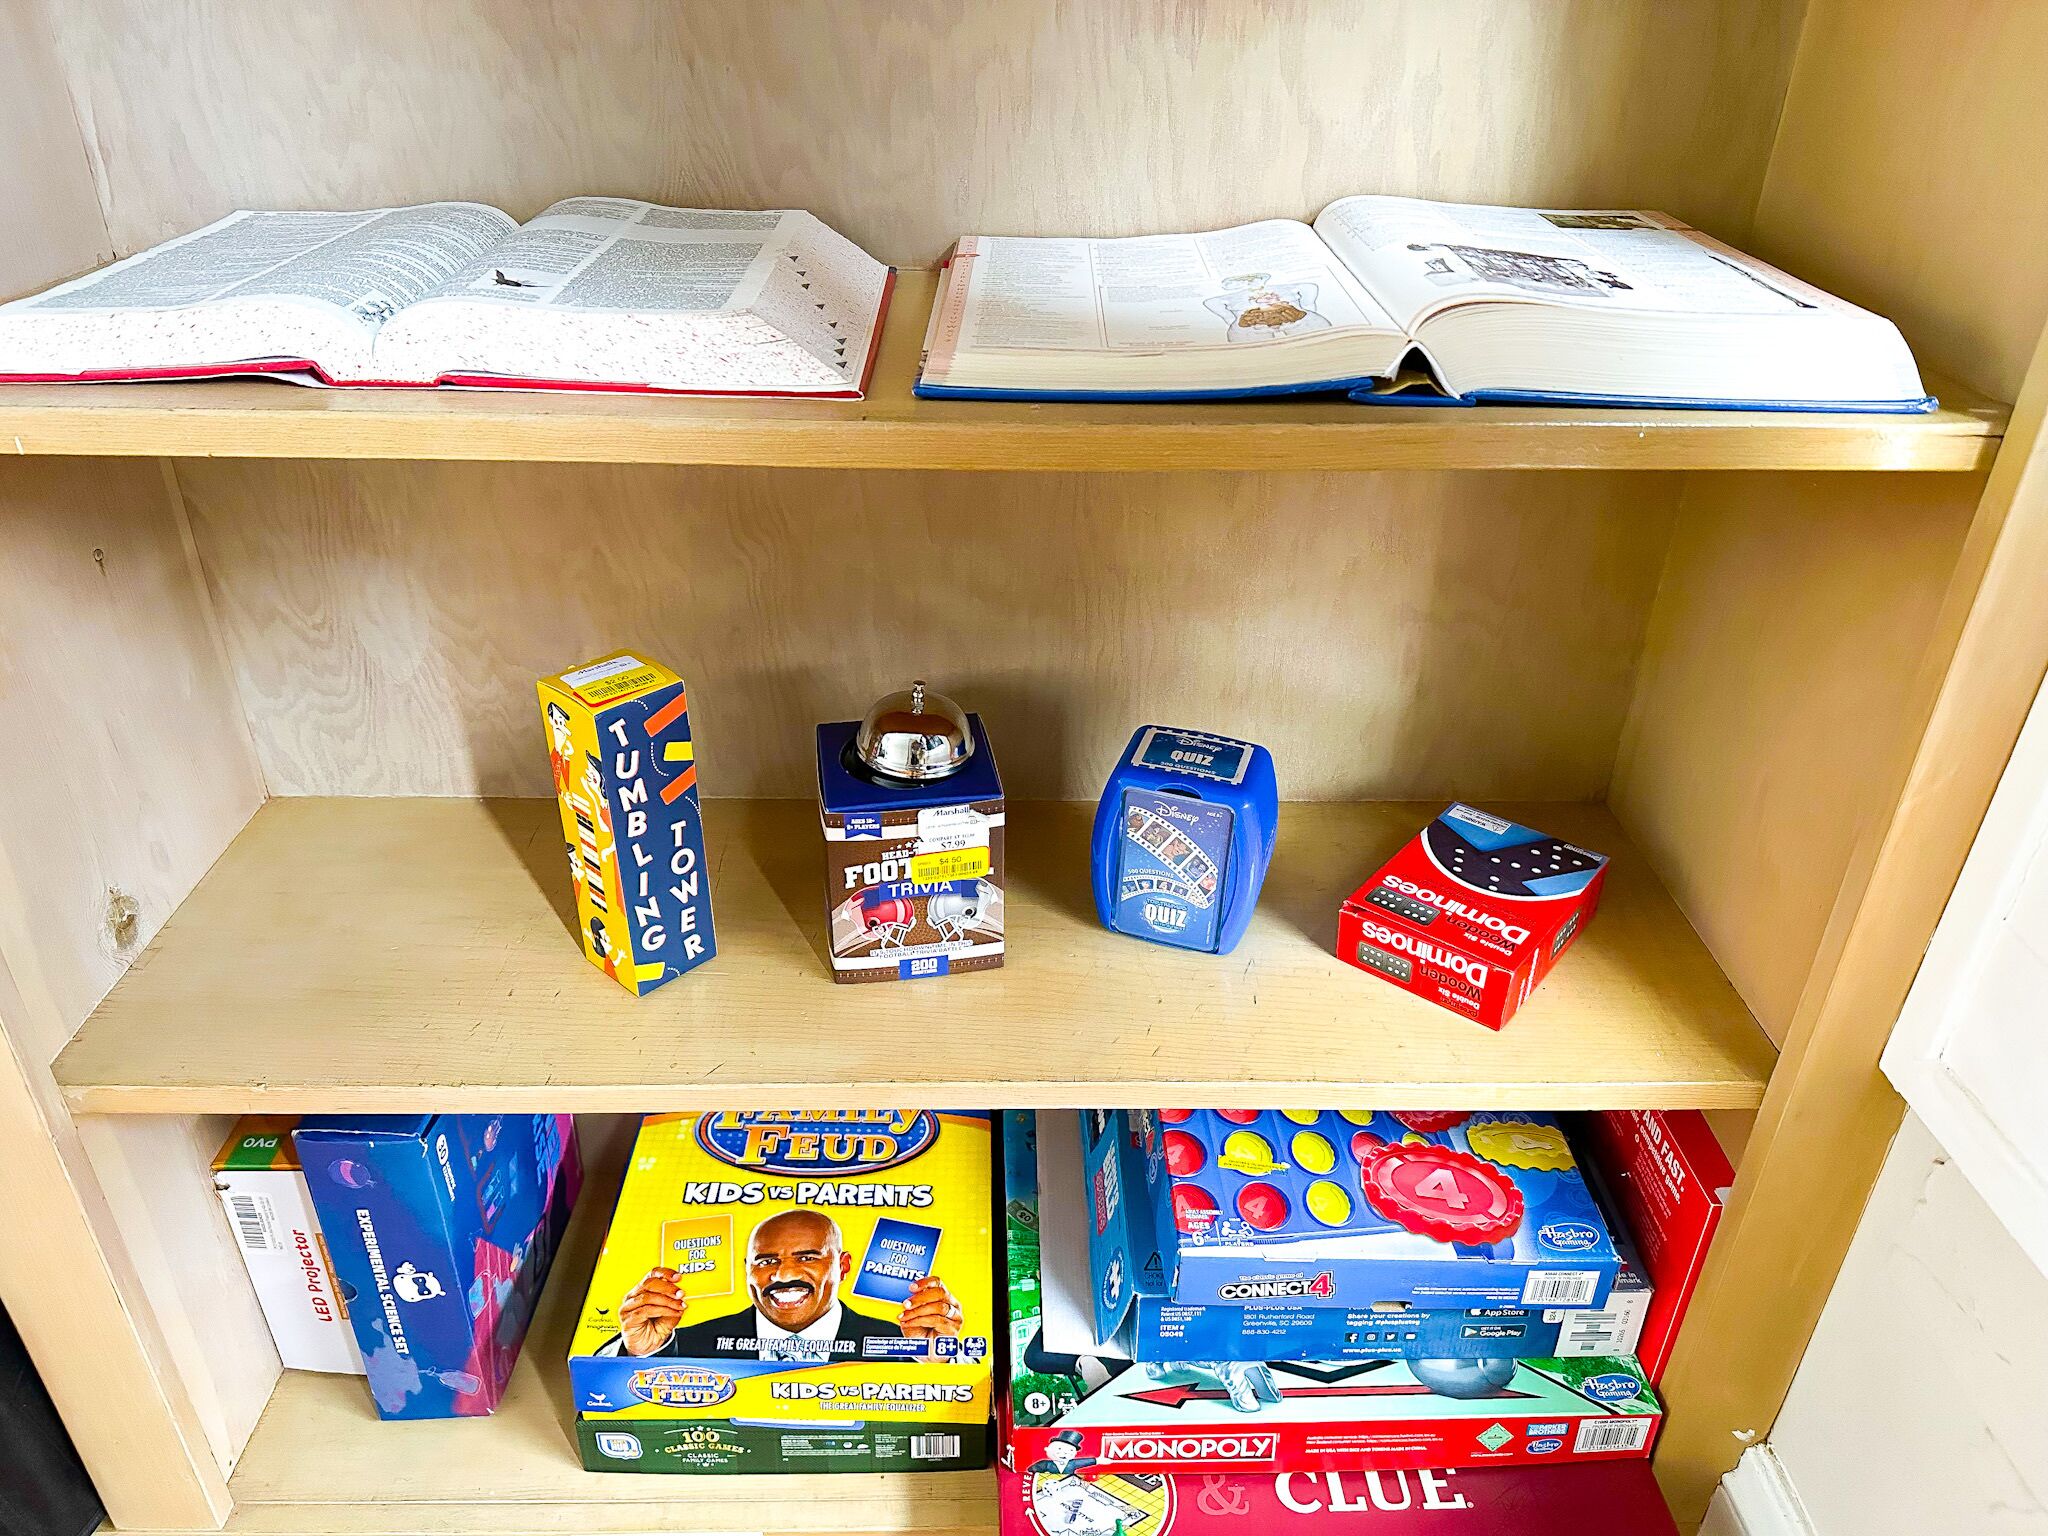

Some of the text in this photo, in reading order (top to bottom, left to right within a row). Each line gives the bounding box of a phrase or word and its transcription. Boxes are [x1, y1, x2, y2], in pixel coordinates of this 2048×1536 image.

[1176, 735, 1222, 752] Disney
[1170, 750, 1214, 766] QUIZ
[933, 806, 971, 817] Marshall
[1154, 800, 1199, 826] Disney
[608, 718, 667, 951] TUMBLING
[941, 840, 966, 849] $7.99
[881, 848, 920, 861] HEAD-T
[670, 820, 706, 961] TOWER
[887, 880, 954, 898] TRIVIA
[1145, 903, 1188, 928] QUIZ
[1382, 874, 1531, 945] Dominoes
[1446, 914, 1517, 953] Wooden
[1463, 931, 1513, 956] Double Six
[910, 957, 938, 971] 200
[1362, 921, 1488, 989] Dominoes
[1420, 966, 1482, 1001] Wooden
[1452, 991, 1480, 1010] Double
[735, 1124, 899, 1165] FEUD
[682, 1182, 765, 1205] KIDS
[796, 1182, 935, 1208] PARENTS
[1187, 1221, 1211, 1230] AGES
[1538, 1225, 1594, 1241] Hasbro
[672, 1234, 722, 1250] QUESTIONS
[879, 1238, 928, 1256] QUESTIONS
[1191, 1231, 1211, 1246] 6+
[293, 1229, 322, 1293] Projector
[688, 1249, 707, 1261] FOR
[891, 1253, 909, 1265] FOR
[678, 1260, 716, 1275] KIDS
[864, 1260, 926, 1282] PARENTS
[355, 1208, 410, 1355] EXPERIMENTAL SCIENCE SET
[1220, 1272, 1332, 1299] CONNECT 4
[312, 1297, 333, 1322] LED
[1484, 1309, 1502, 1317] App
[1505, 1330, 1522, 1338] Play
[716, 1336, 735, 1350] THE
[735, 1337, 766, 1351] GREAT
[767, 1338, 801, 1353] FAMILY
[802, 1338, 856, 1354] EQUALIZER
[936, 1341, 957, 1355] 8+
[634, 1369, 732, 1391] FAMILY
[1582, 1377, 1636, 1392] Hasbro
[651, 1385, 720, 1404] FEUD
[771, 1382, 836, 1399] KIDS
[861, 1382, 974, 1403] PARENTS
[1595, 1388, 1634, 1400] Gaming
[819, 1401, 927, 1412] THE GREAT FAMILY EQUALIZER
[1031, 1397, 1047, 1409] 8+
[682, 1431, 720, 1443] 100
[664, 1442, 745, 1454] CLASSIC GAMES
[1107, 1435, 1271, 1460] MONOPOLY
[1196, 1472, 1250, 1516] &
[1274, 1467, 1467, 1514] CLUE
